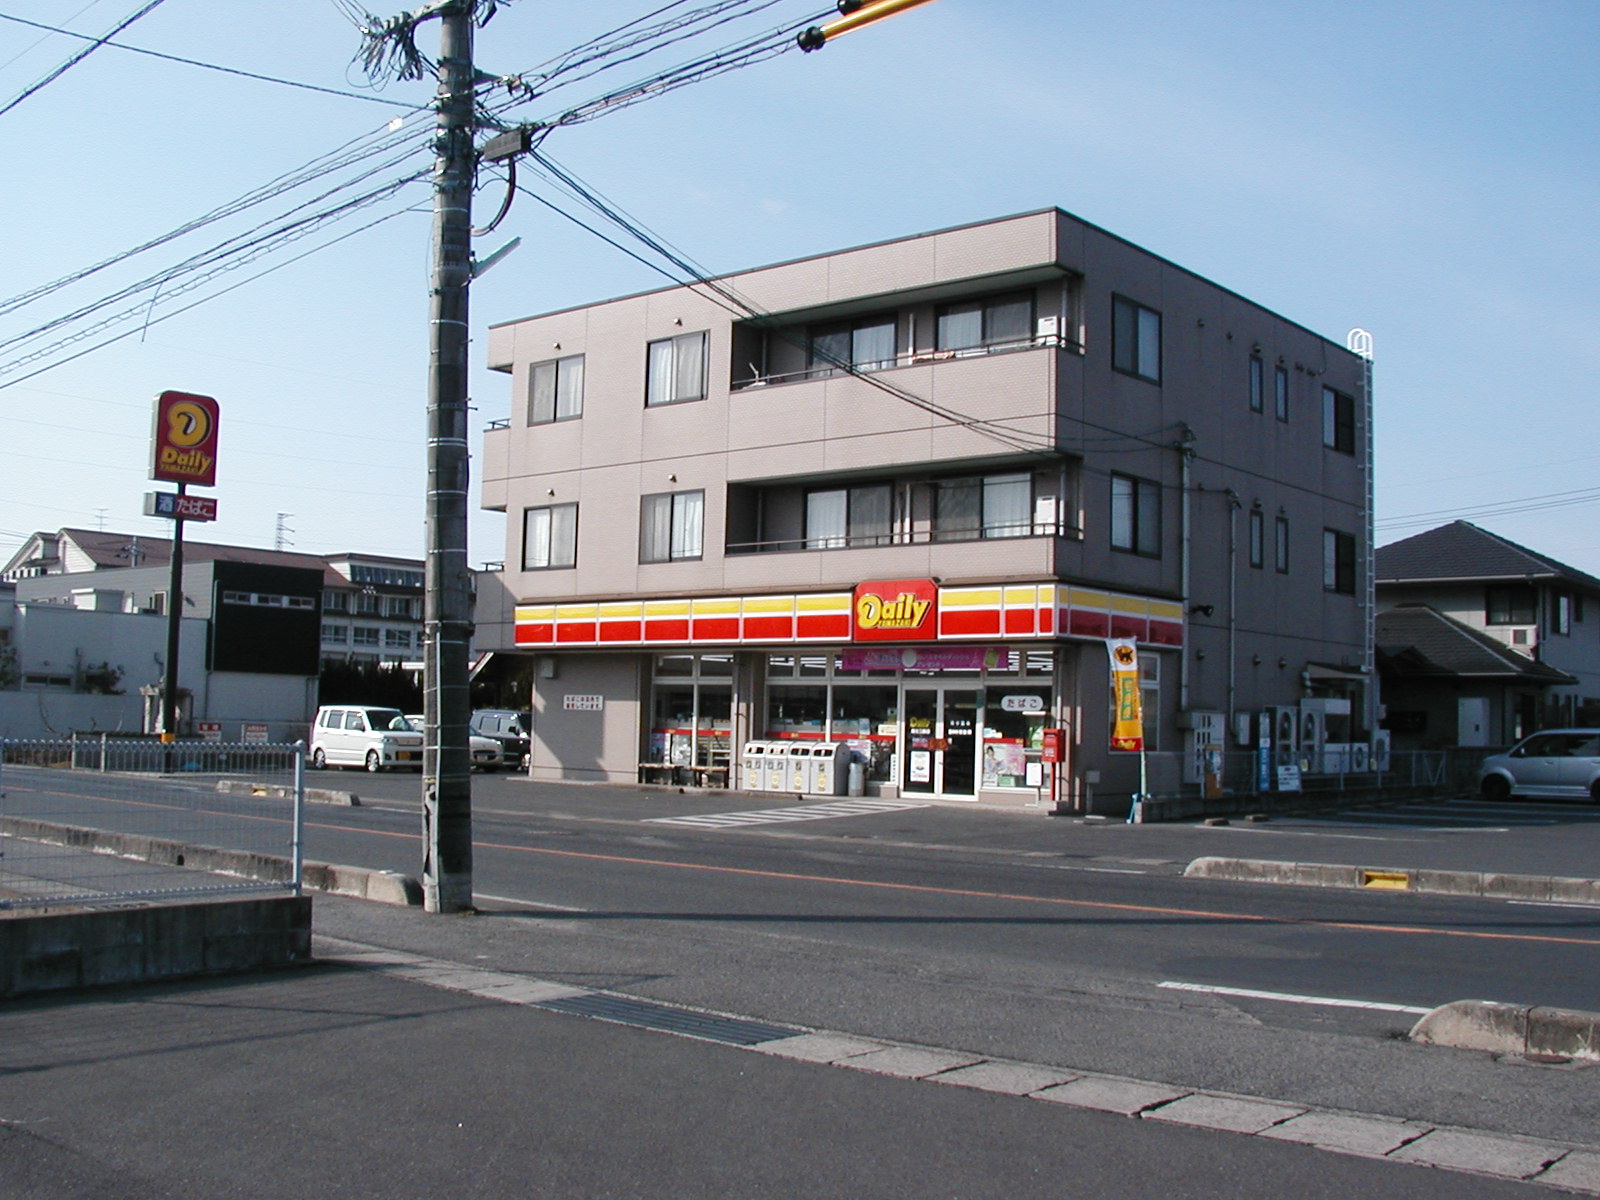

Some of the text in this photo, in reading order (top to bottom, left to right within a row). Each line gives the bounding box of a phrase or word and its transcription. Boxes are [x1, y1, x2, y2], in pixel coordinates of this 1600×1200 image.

[162, 447, 213, 474] Daily
[159, 495, 173, 512] 酒
[177, 499, 214, 517] たばこ
[857, 593, 931, 628] Daily
[1007, 698, 1037, 708] たばこ
